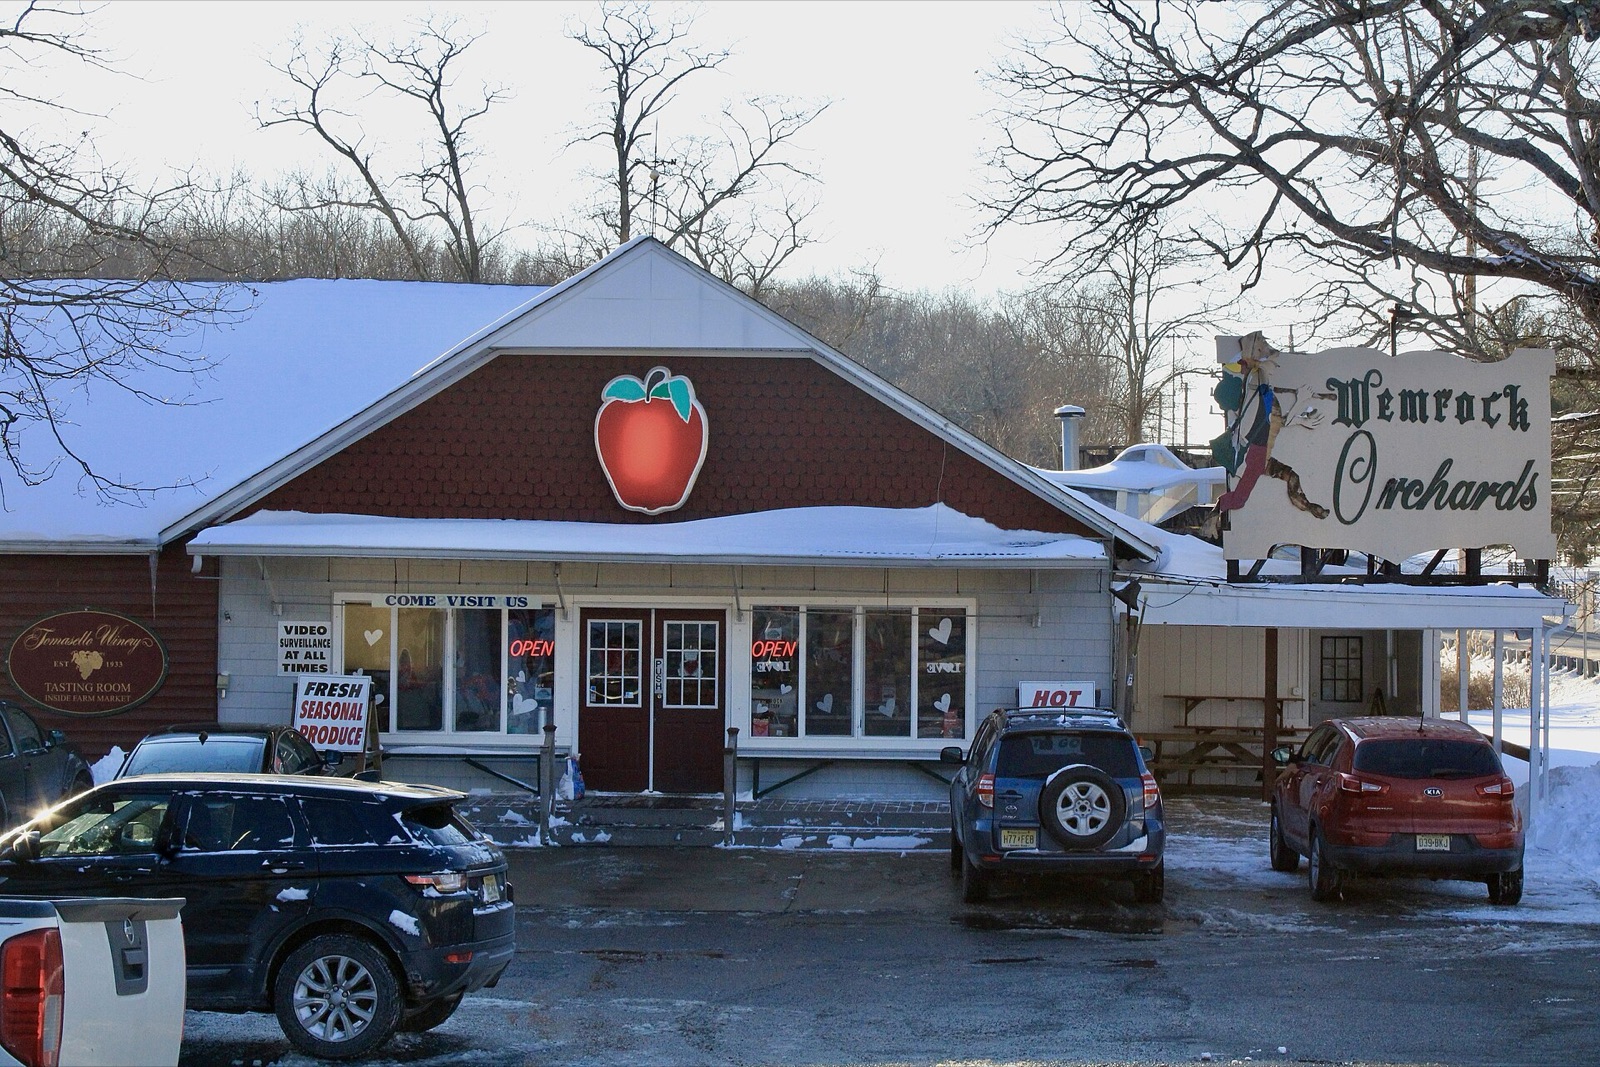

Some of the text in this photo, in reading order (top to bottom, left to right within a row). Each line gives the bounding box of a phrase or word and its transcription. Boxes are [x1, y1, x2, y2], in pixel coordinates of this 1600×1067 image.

[1326, 368, 1530, 432] Wemrock
[1333, 430, 1539, 525] Orchards
[385, 595, 528, 608] COME VISIT US
[284, 625, 328, 635] VIDEO
[24, 624, 153, 655] Tomasello Winery
[280, 638, 331, 648] SURVEILLANCE
[284, 651, 326, 660] AT ALL
[510, 639, 554, 657] OPEN
[752, 640, 797, 658] OPEN
[53, 660, 69, 668] EST
[282, 663, 328, 672] TIMES
[44, 682, 131, 693] TASTING ROOM
[304, 682, 363, 698] FRESH
[1032, 690, 1082, 706] HOT
[300, 700, 363, 720] SEASONAL
[300, 725, 363, 745] PRODUCE
